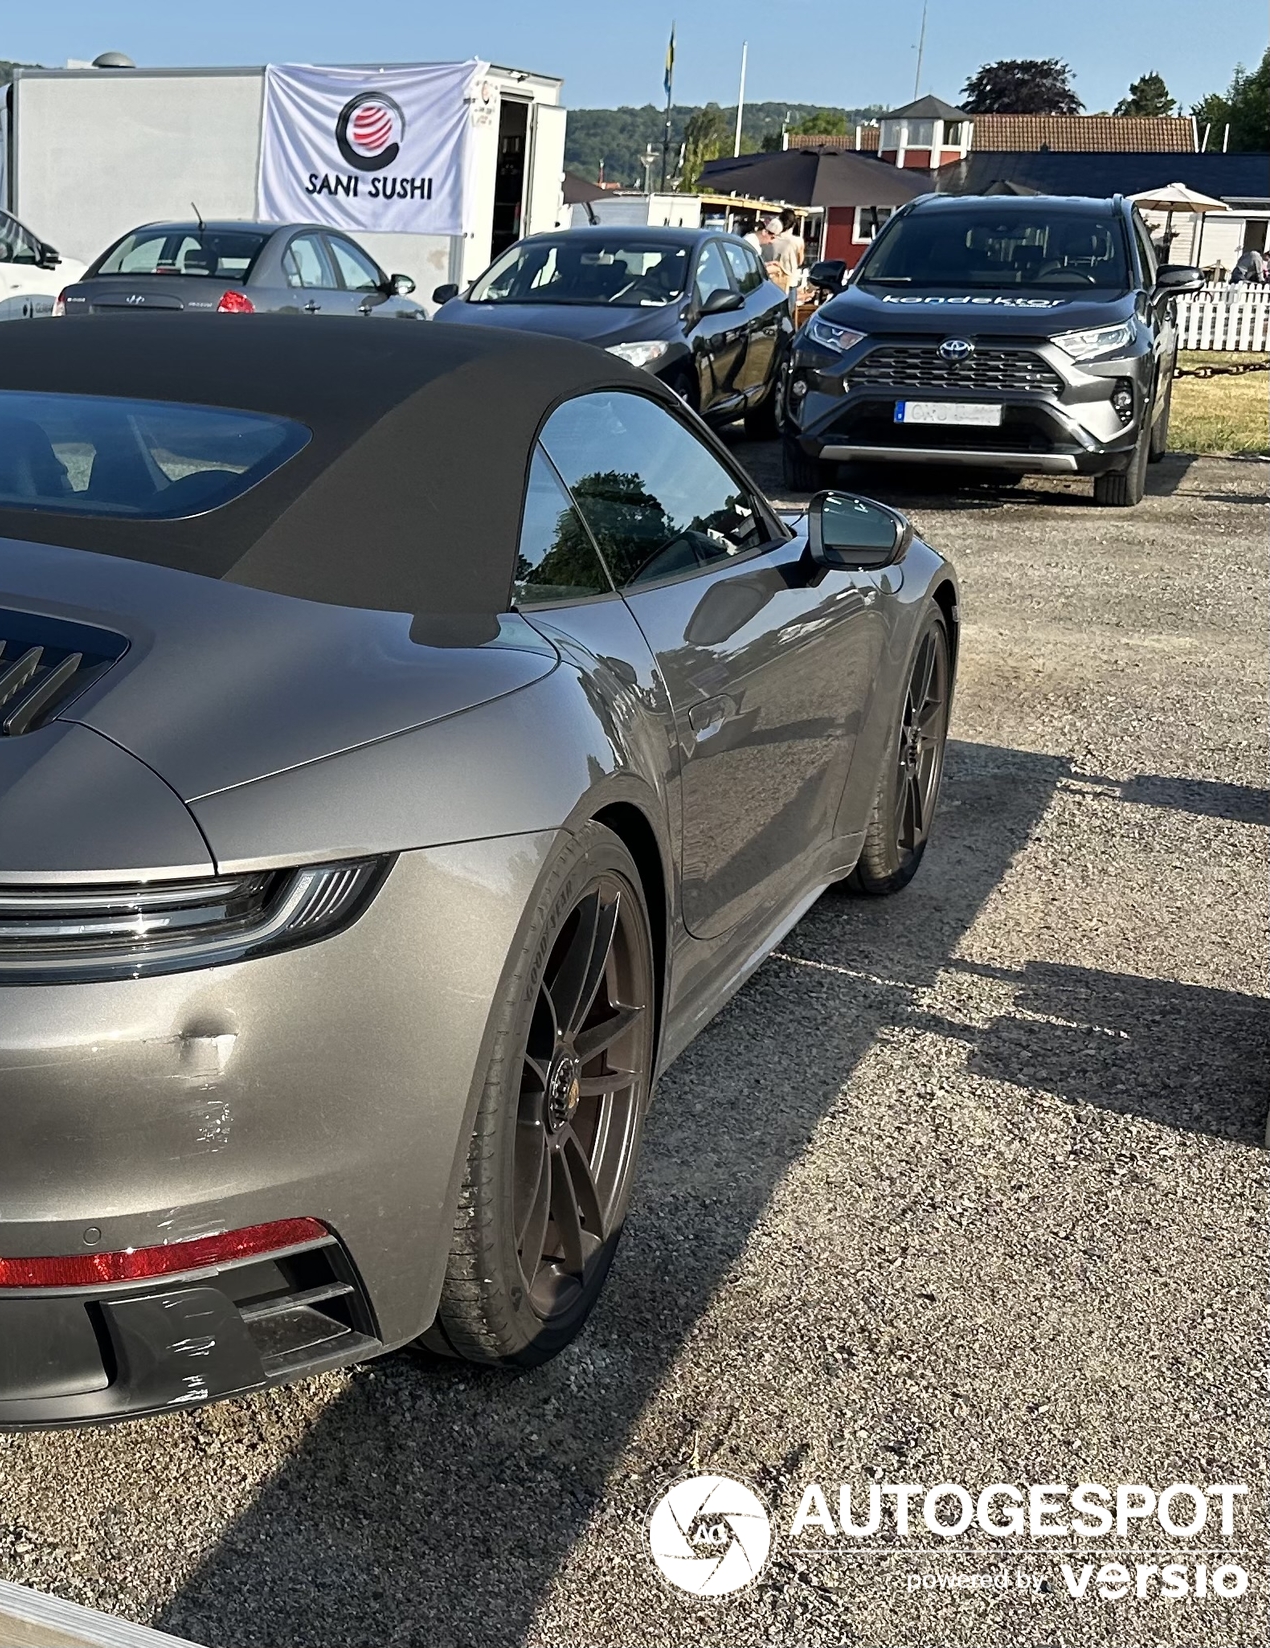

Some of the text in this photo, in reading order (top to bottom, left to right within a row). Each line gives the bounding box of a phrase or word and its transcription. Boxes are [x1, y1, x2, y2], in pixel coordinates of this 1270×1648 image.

[305, 173, 433, 200] SANI SUSHI
[882, 294, 1066, 306] kondektor
